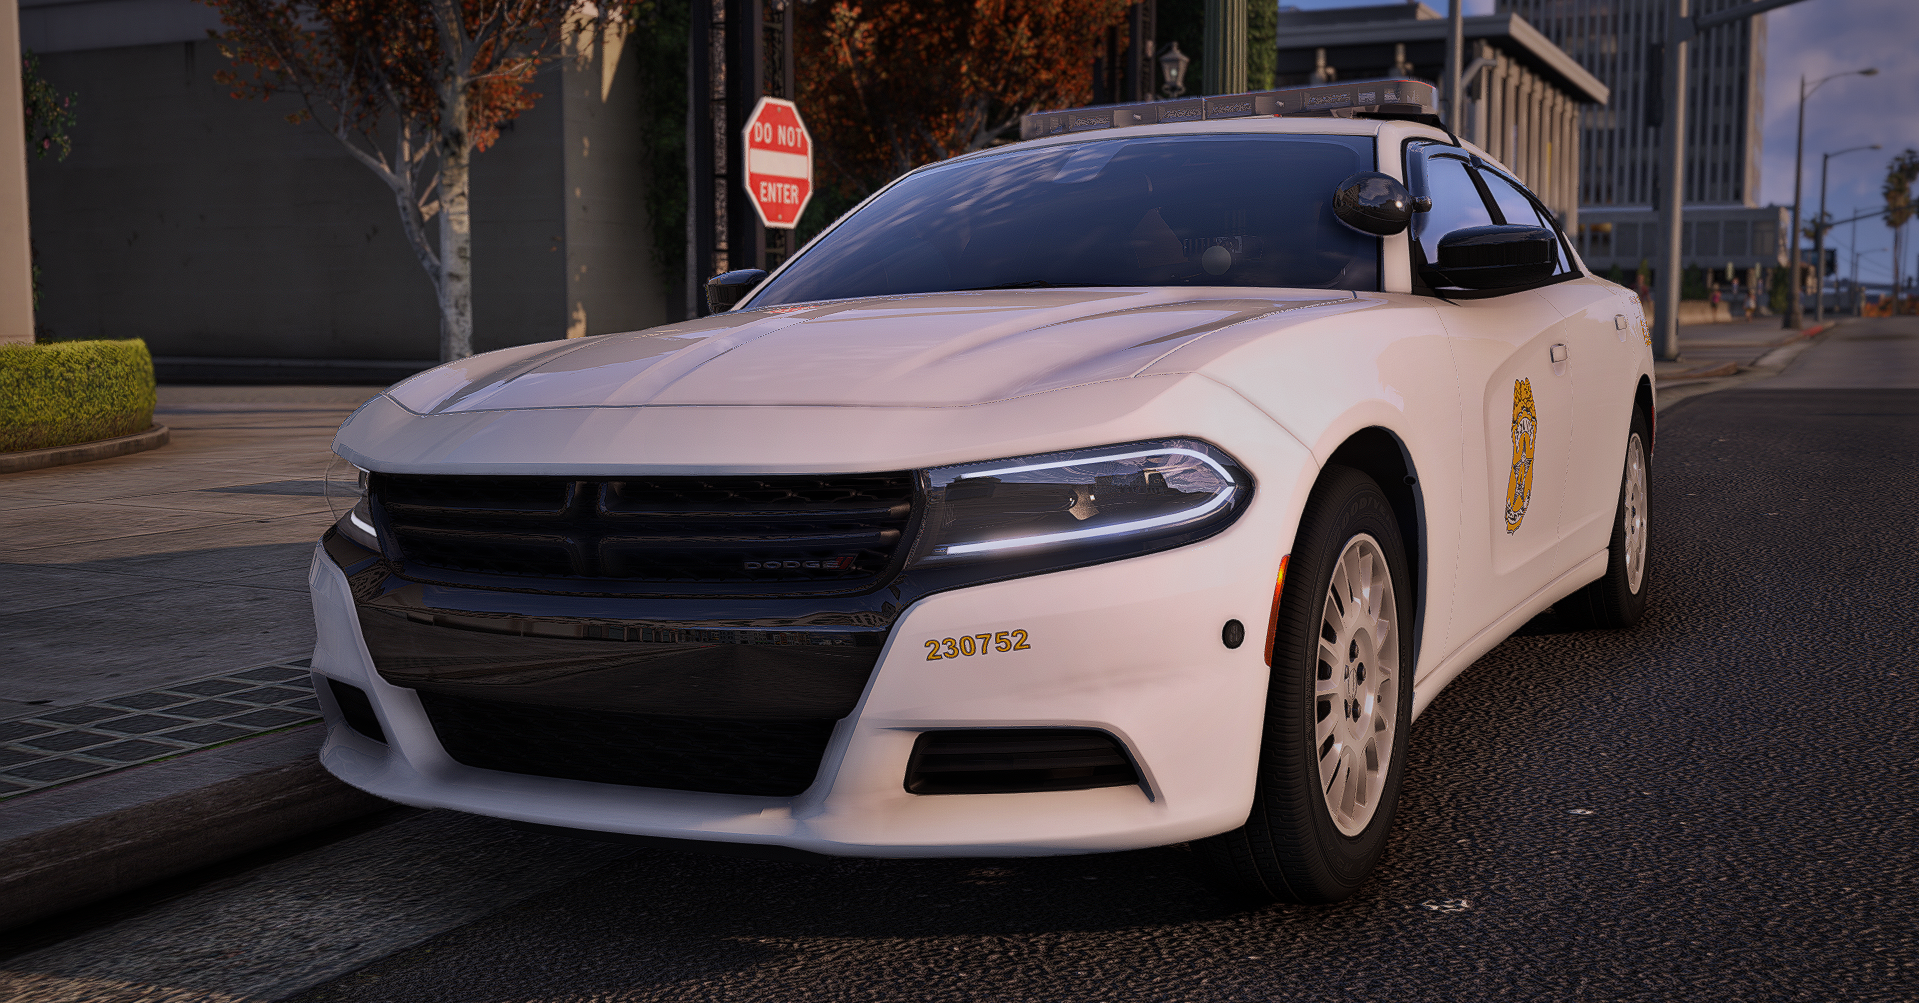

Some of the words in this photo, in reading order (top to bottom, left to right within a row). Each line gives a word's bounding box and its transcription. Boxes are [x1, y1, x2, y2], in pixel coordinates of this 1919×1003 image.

[754, 121, 773, 144] DO
[777, 125, 803, 148] NOT
[760, 181, 799, 205] ENTER
[743, 560, 840, 570] DODGE
[924, 629, 1031, 661] 230752
